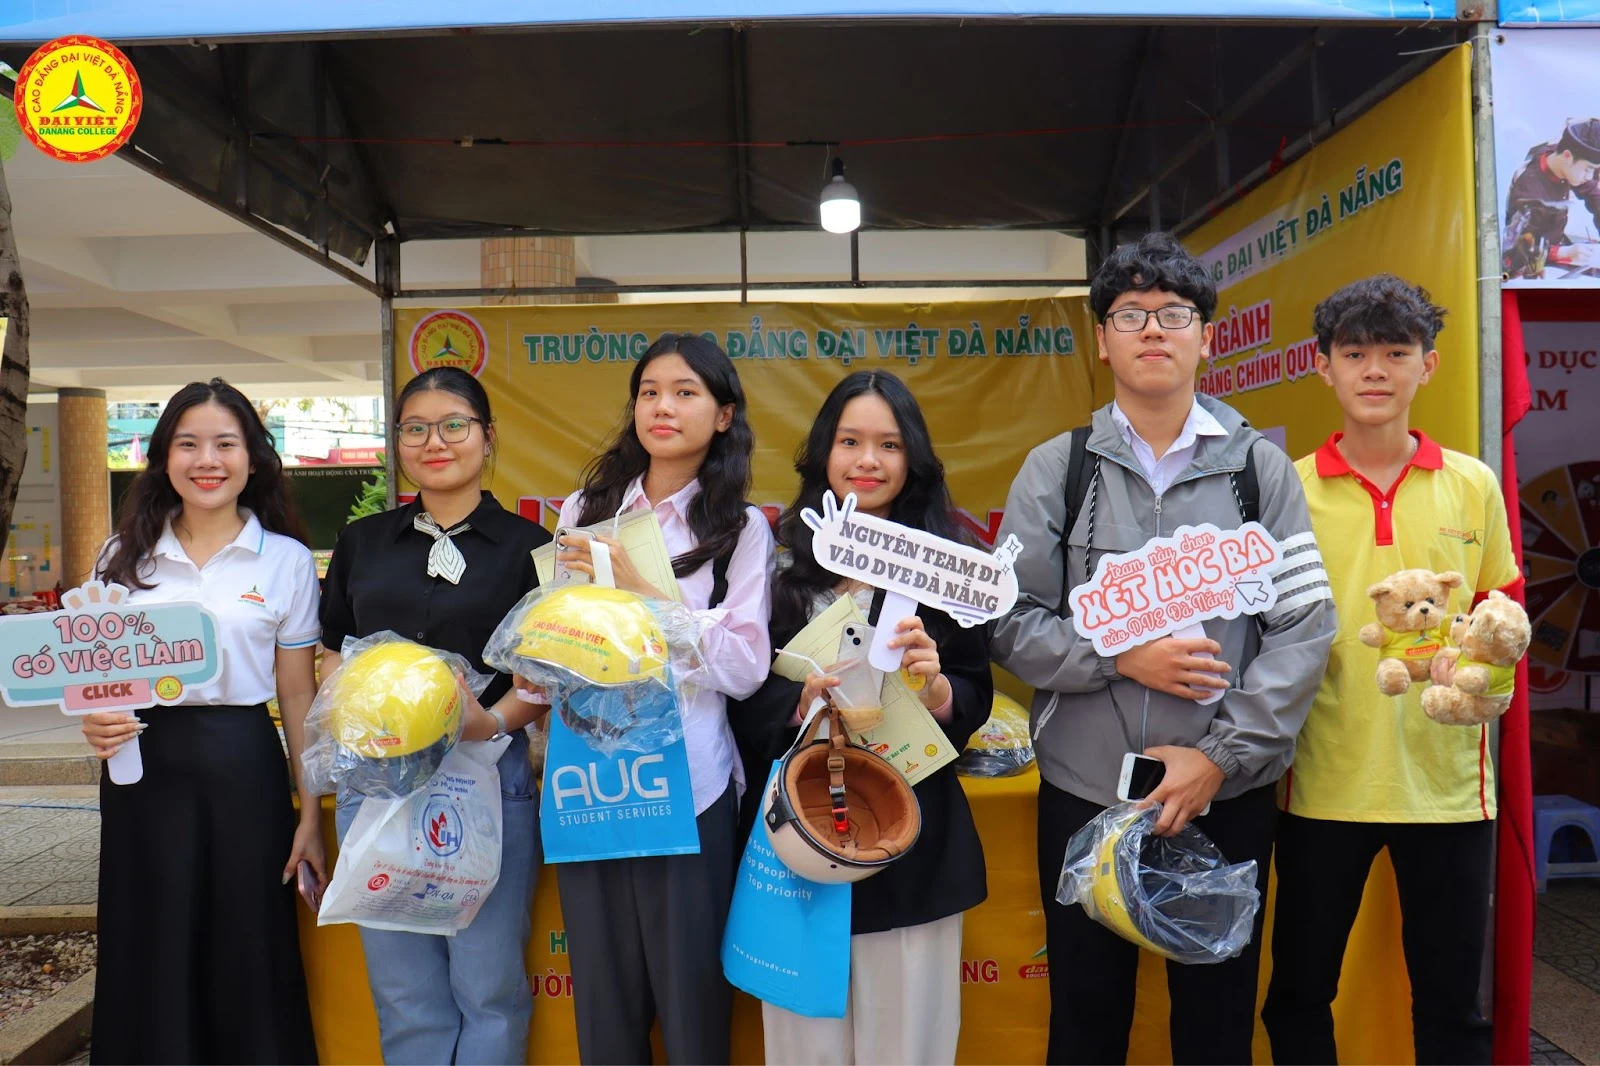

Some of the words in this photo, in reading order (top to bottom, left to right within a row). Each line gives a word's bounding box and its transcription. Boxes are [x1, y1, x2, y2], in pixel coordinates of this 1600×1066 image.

[1227, 244, 1252, 275] ĐẠI
[1257, 220, 1299, 257] VIỆT
[1304, 195, 1333, 240] ĐÀ
[1338, 158, 1402, 219] NẴNG
[523, 327, 648, 363] TRƯỜNG
[726, 316, 808, 359] ĐẲNG
[816, 328, 866, 365] ĐẠI
[874, 322, 940, 364] VIỆT
[948, 322, 987, 357] ĐÀ
[995, 314, 1074, 356] NẴNG
[1208, 300, 1272, 362] NGÀNH
[1236, 350, 1281, 392] CHÍNH
[1286, 338, 1319, 382] QUY
[1538, 350, 1598, 374] DỤC
[839, 520, 920, 560] NGUYÊN
[922, 548, 976, 578] TEAM
[1106, 558, 1144, 580] team
[1148, 546, 1176, 566] này
[830, 544, 869, 572] VÀO
[870, 558, 912, 586] DVE
[912, 572, 941, 596] ĐÀ
[943, 578, 999, 613] NẴNG
[1078, 572, 1150, 630] XÉT
[1166, 600, 1194, 621] Đà
[1190, 587, 1234, 611] Nẵng
[53, 612, 154, 644] 100%
[568, 628, 585, 640] ĐẠI
[586, 632, 606, 646] VIỆT
[82, 682, 134, 700] CLICK
[552, 754, 670, 810] AUG
[560, 810, 612, 826] STUDENT
[618, 804, 672, 820] SERVICES
[748, 873, 762, 890] Top
[766, 884, 812, 901] Priority
[758, 862, 798, 880] People
[961, 958, 1000, 984] NG
